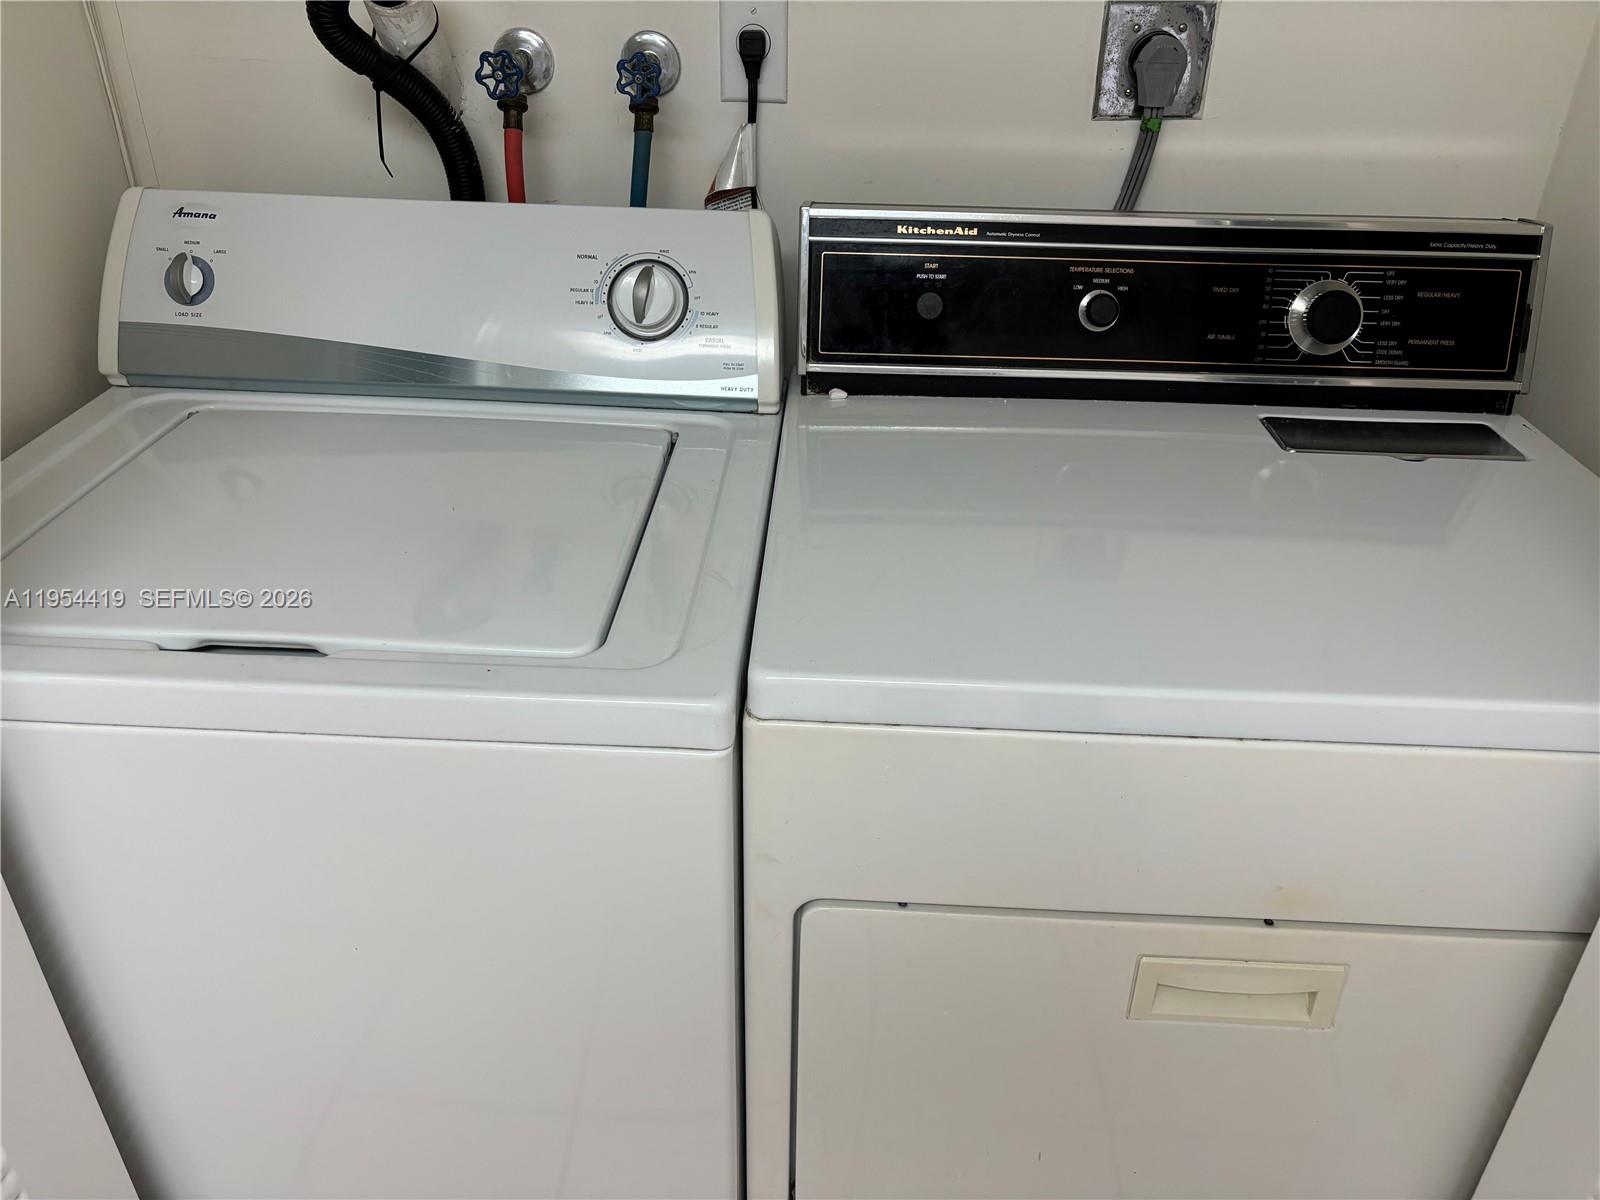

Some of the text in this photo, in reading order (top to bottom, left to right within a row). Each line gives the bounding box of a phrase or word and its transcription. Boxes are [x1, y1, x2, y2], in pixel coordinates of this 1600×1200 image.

[172, 206, 217, 220] Amana
[896, 224, 978, 236] KitchenAid
[1069, 266, 1104, 274] TEMPERATURE
[1407, 338, 1440, 346] PERMANENT
